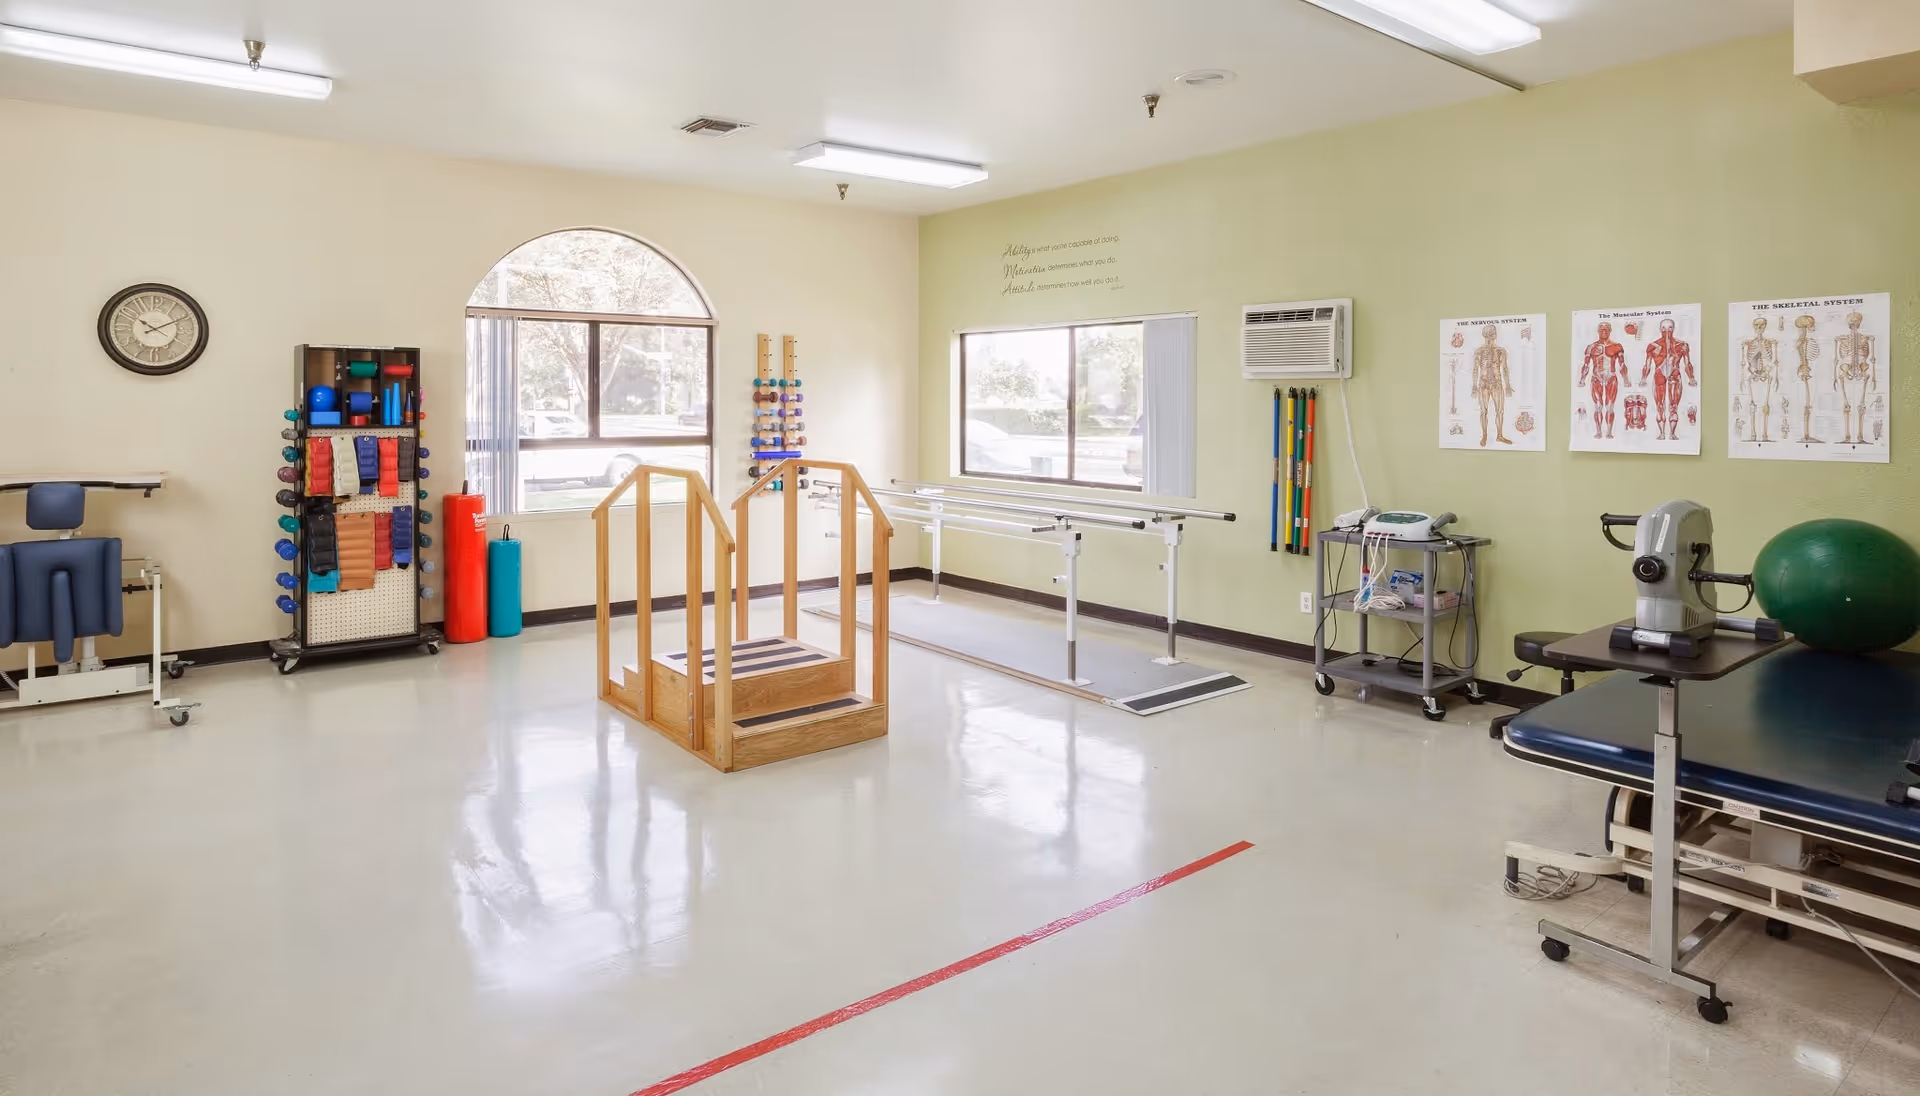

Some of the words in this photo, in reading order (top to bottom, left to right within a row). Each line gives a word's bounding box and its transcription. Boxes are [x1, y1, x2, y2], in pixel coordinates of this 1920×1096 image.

[1002, 243, 1031, 261] Ability
[1036, 244, 1050, 252] what
[1068, 239, 1093, 249] capable
[1093, 236, 1101, 245] of
[1003, 263, 1046, 280] Motivation
[1047, 262, 1079, 272] determines
[1079, 259, 1094, 267] what
[1094, 259, 1106, 267] you
[1002, 281, 1036, 296] Attitude
[1036, 281, 1067, 291] determines
[1067, 280, 1080, 288] how
[1092, 279, 1105, 288] you
[1104, 276, 1114, 284] do
[1772, 301, 1821, 309] SKELETAL
[1823, 298, 1864, 306] SYSTEM
